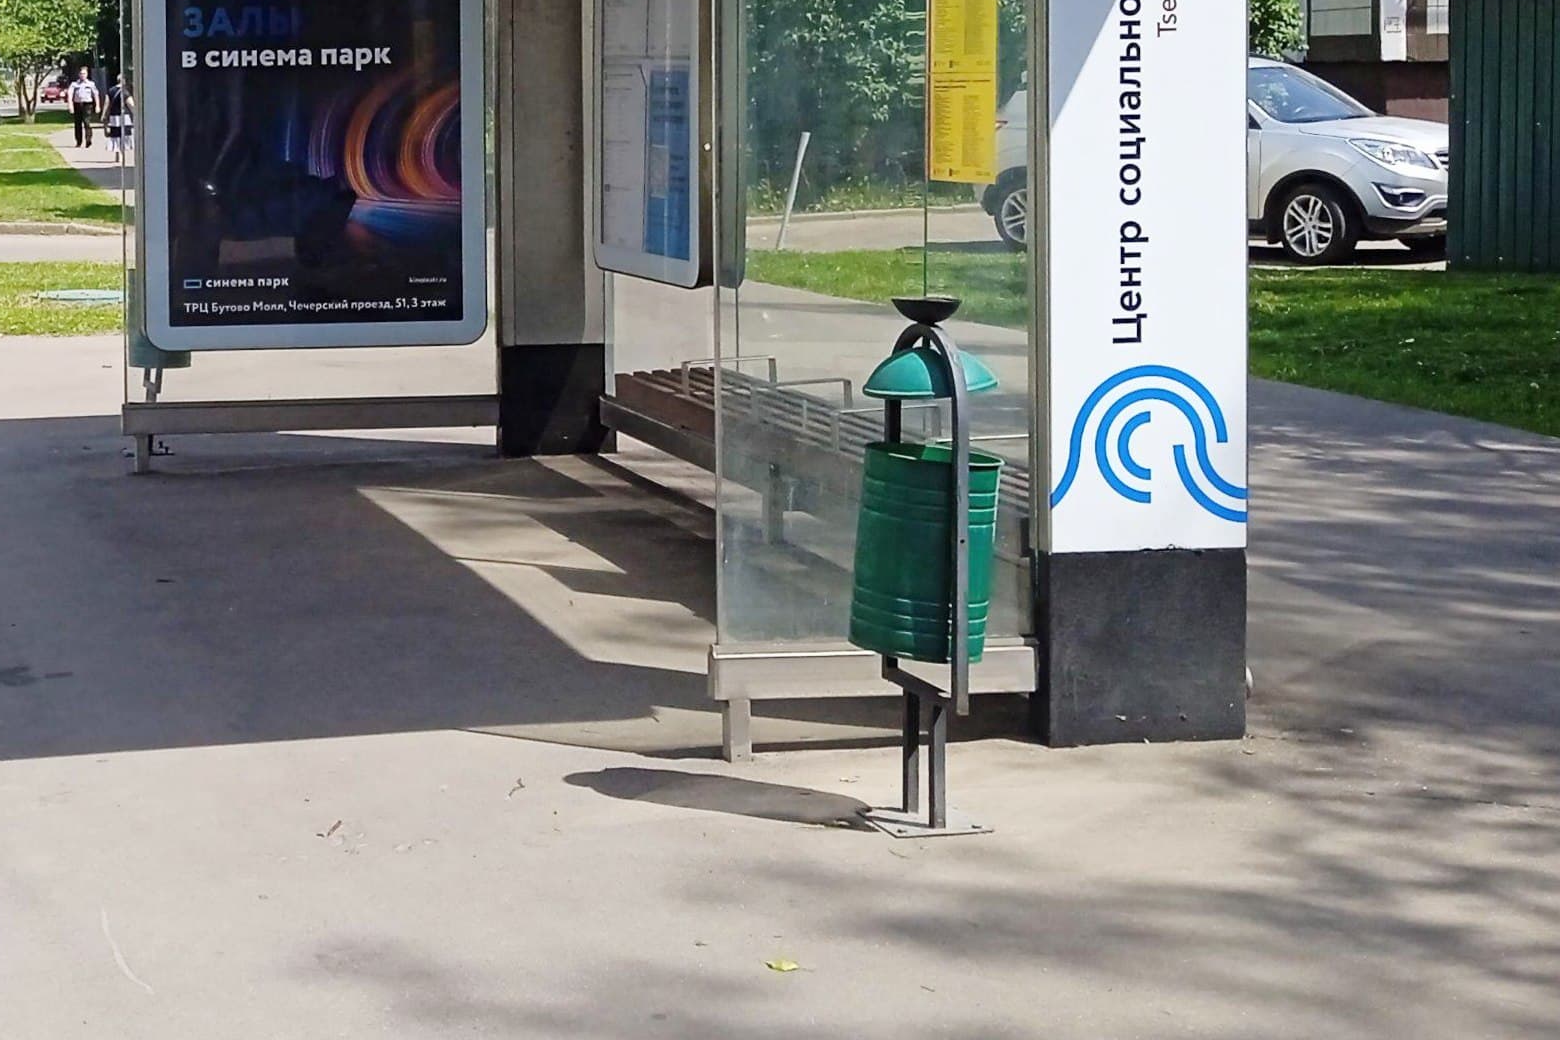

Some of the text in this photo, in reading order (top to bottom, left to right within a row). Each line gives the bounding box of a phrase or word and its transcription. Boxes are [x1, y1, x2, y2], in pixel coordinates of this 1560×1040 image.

[183, 5, 300, 39] ЗАЛЫ
[181, 45, 392, 72] в синема парк
[205, 276, 289, 289] синема парк
[1112, 220, 1149, 344] Центр
[184, 302, 209, 315] ТРЦ
[211, 301, 251, 315] Бутово
[252, 300, 288, 313] Молл,
[419, 299, 447, 309] этаж
